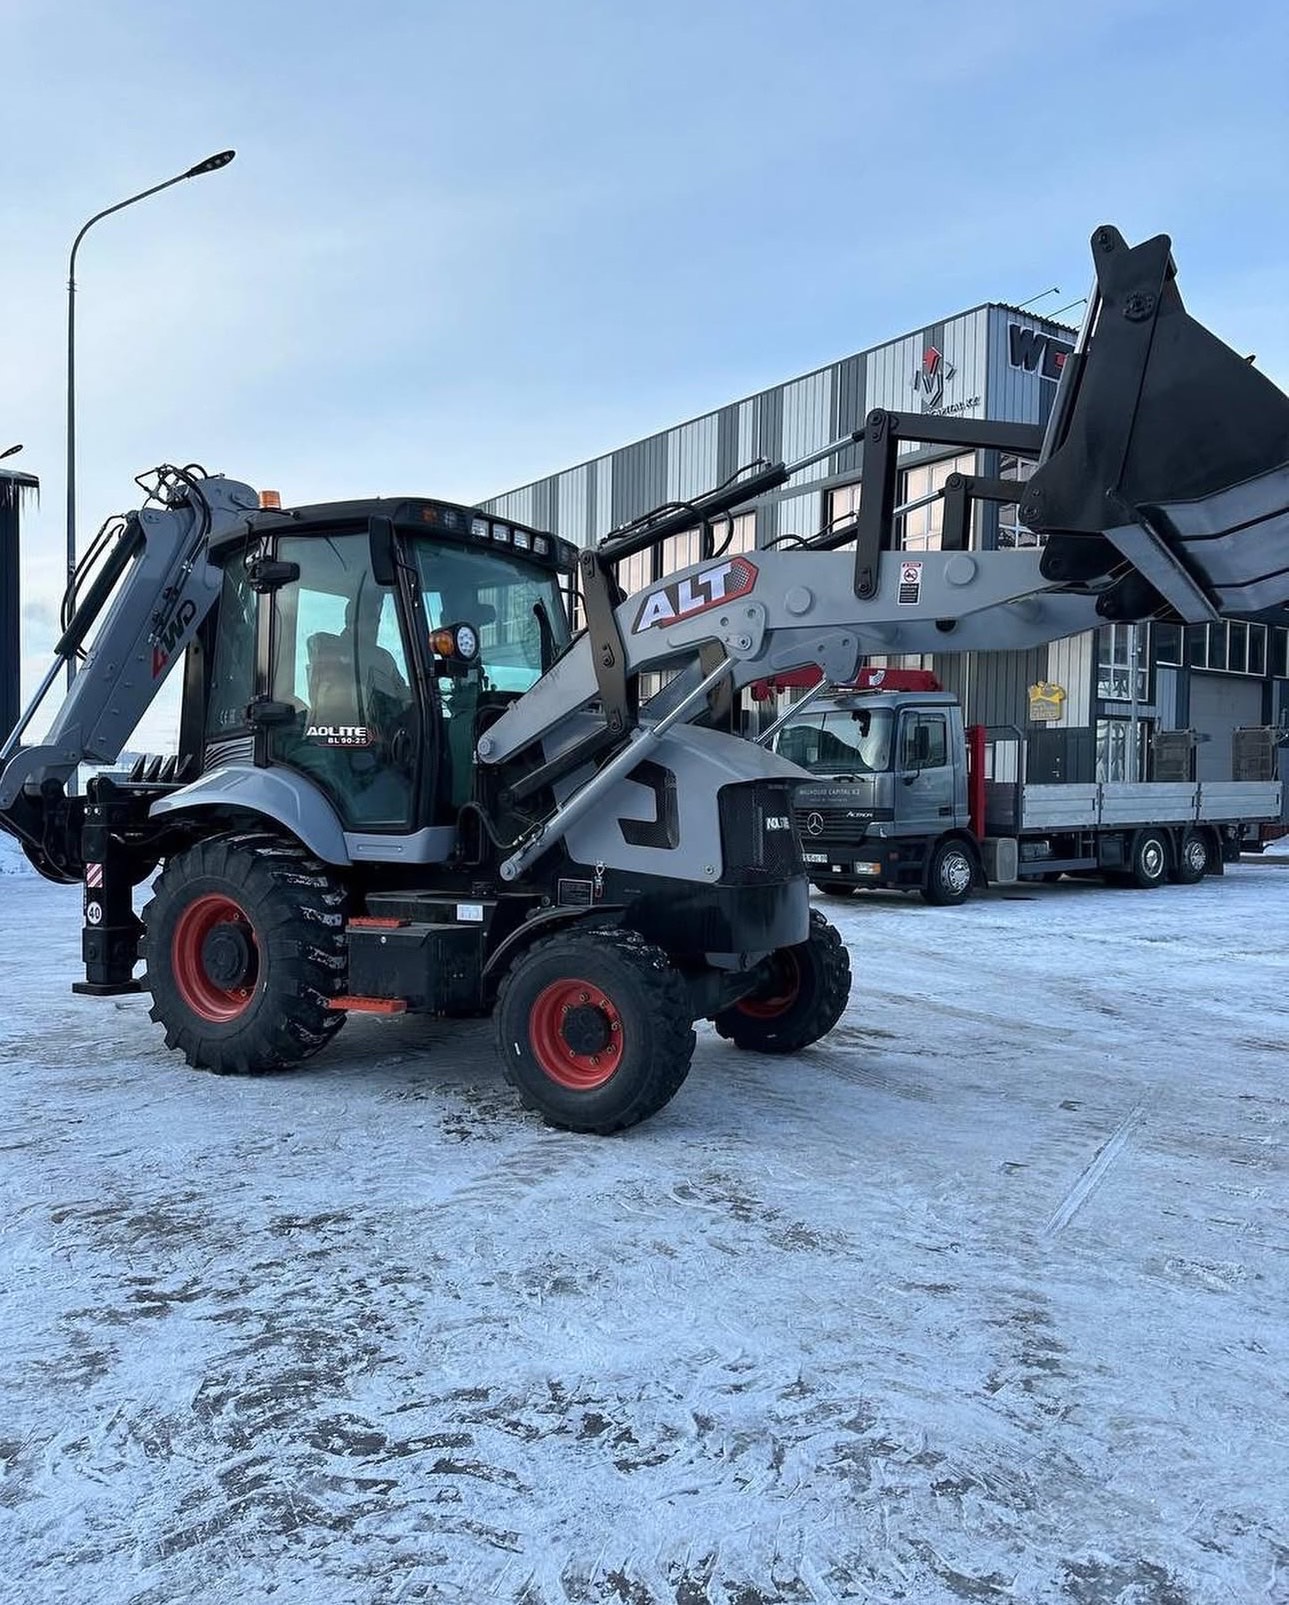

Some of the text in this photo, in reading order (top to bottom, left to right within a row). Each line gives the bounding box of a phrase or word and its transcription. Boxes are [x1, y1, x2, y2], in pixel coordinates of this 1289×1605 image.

[636, 562, 732, 632] ALT
[306, 726, 367, 736] AOLITE
[89, 907, 101, 920] 40
